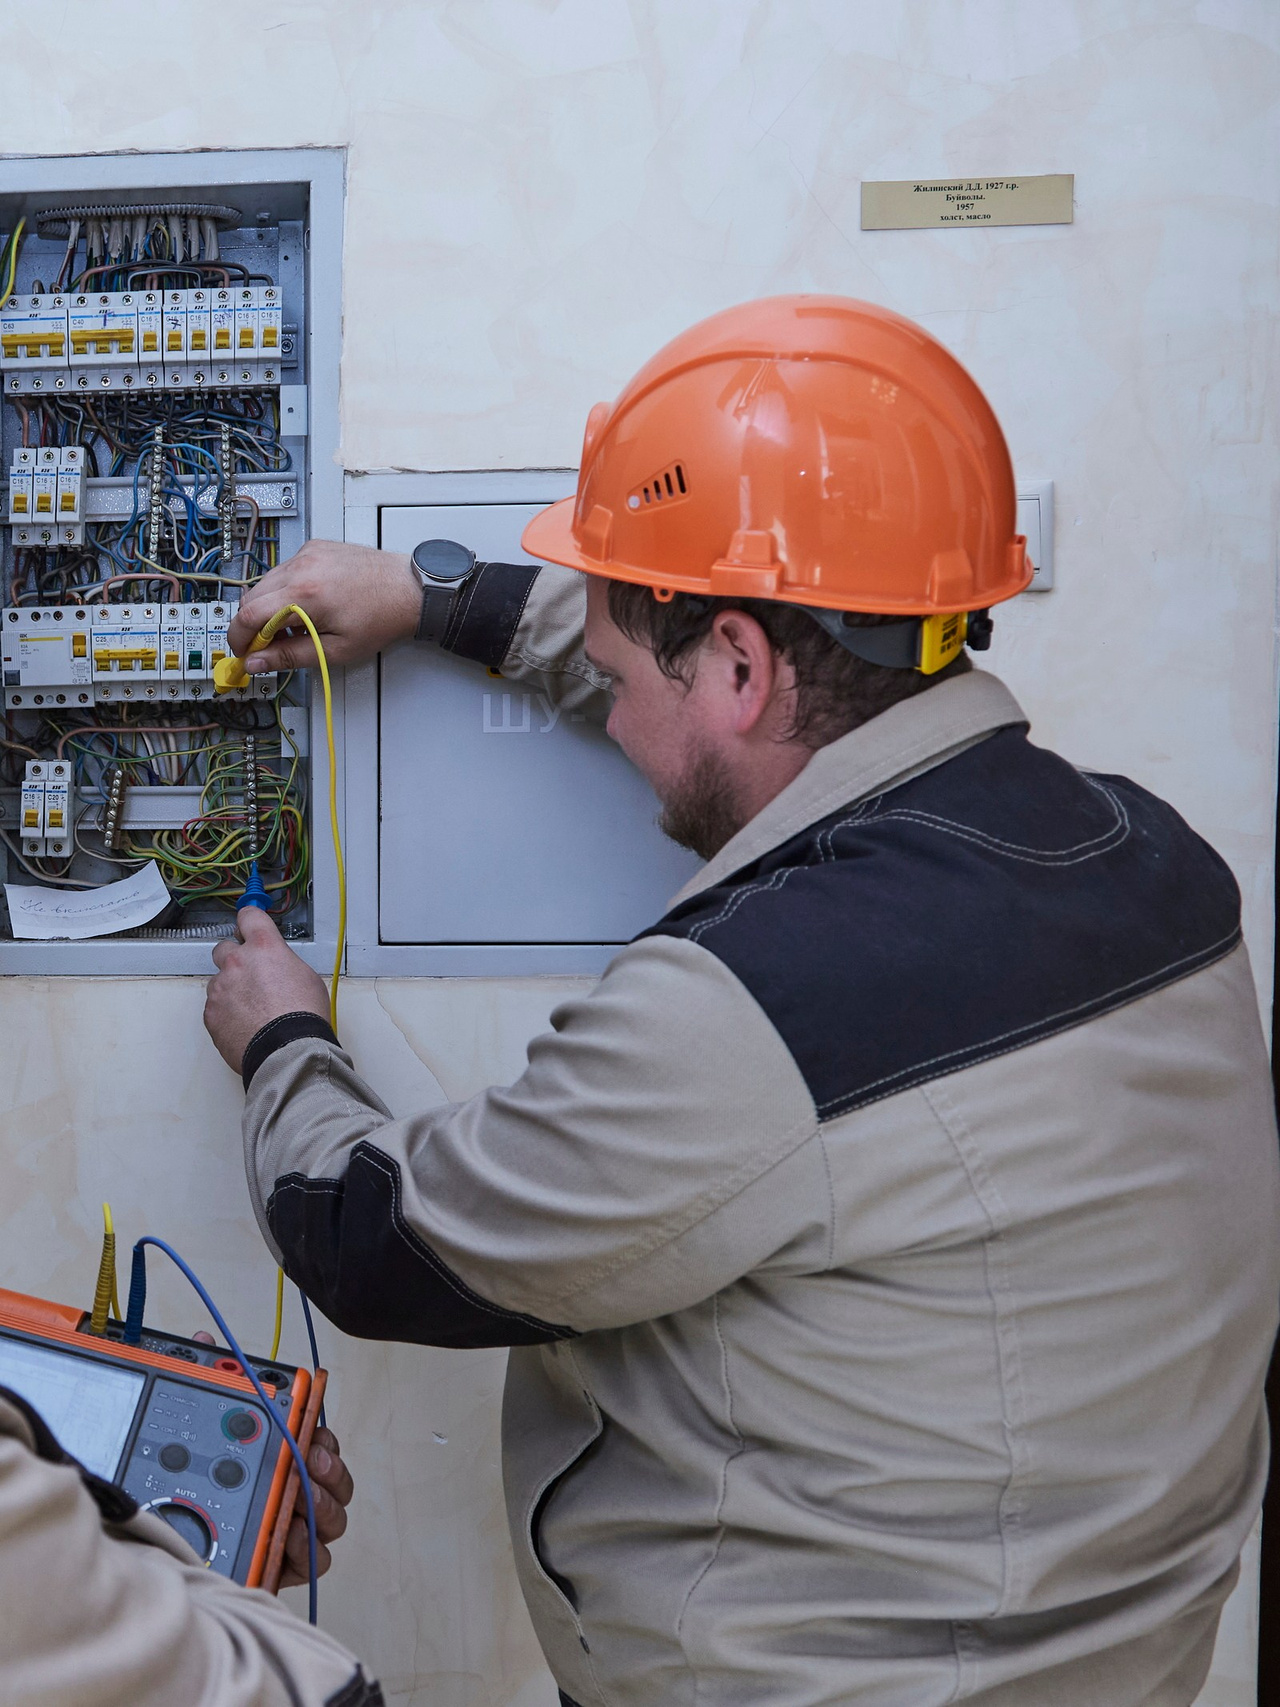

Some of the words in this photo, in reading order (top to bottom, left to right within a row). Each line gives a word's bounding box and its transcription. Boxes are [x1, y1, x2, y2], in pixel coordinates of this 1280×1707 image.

[913, 183, 964, 193] Жилинский
[965, 183, 983, 192] Д.Д.
[985, 182, 1004, 190] 1927
[1005, 182, 1020, 191] г.р.
[946, 194, 986, 203] Буйволы.
[956, 203, 975, 211] 1957
[966, 213, 992, 221] масло
[483, 693, 586, 733] ШУ-
[226, 1444, 246, 1455] MENU
[175, 1488, 197, 1498] AUTO
